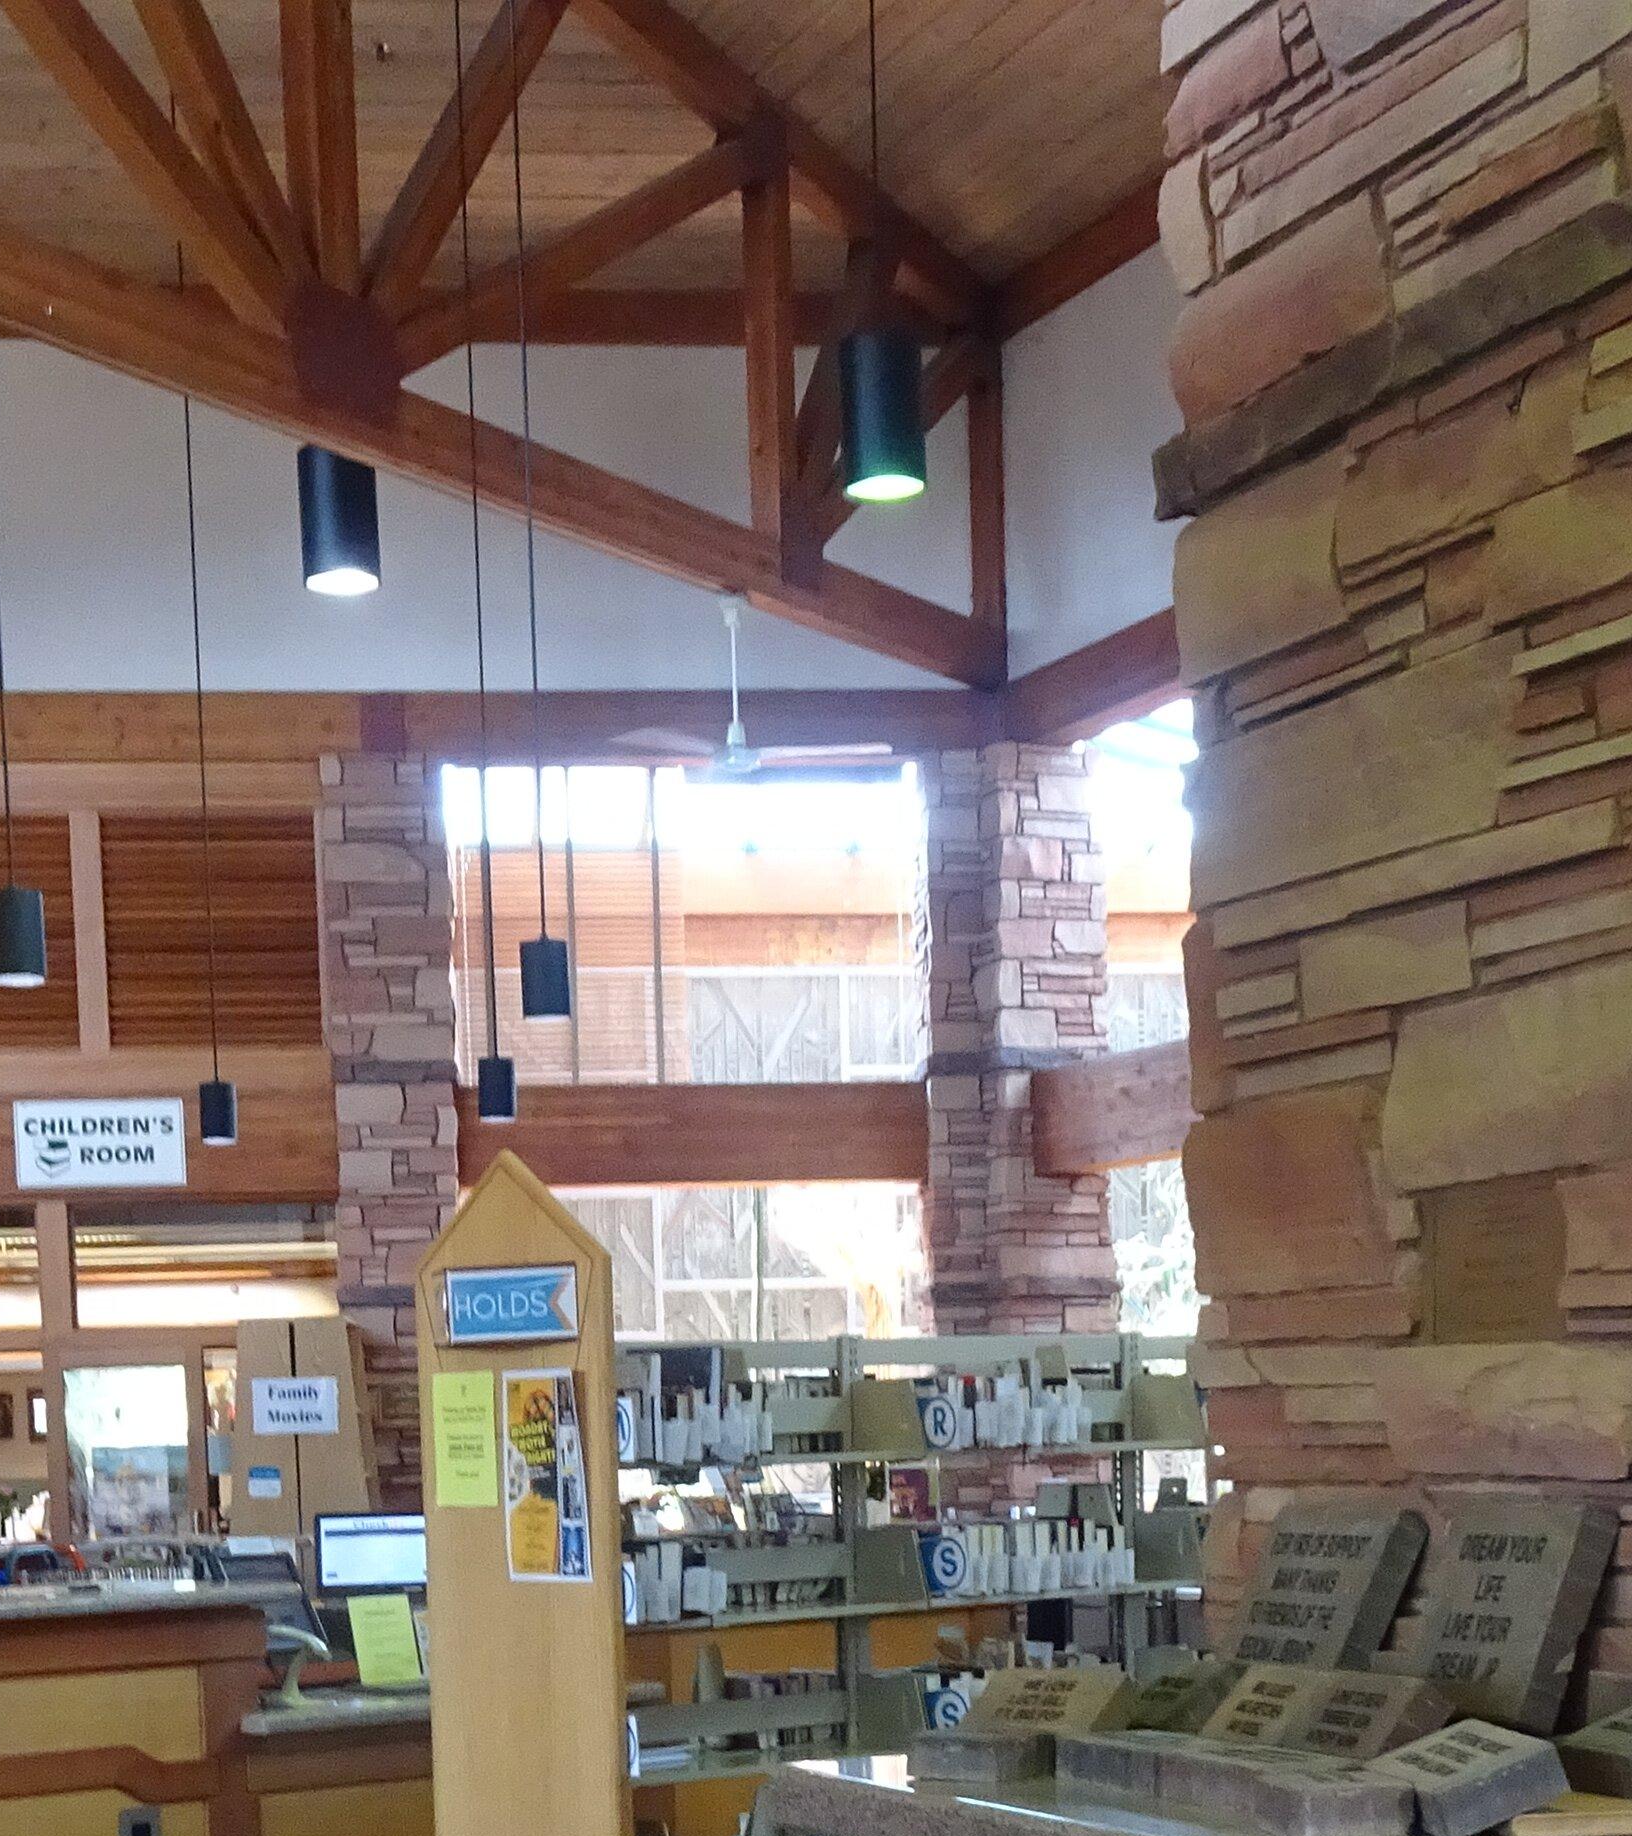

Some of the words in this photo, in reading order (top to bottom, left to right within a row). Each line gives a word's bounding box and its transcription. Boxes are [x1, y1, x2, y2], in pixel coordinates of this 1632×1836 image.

[23, 1117, 174, 1136] CHILDREN'S
[79, 1145, 155, 1165] ROOM
[454, 1290, 549, 1321] HOLDS
[268, 1385, 320, 1402] Family
[268, 1409, 323, 1423] Movies
[933, 1407, 947, 1436] R
[940, 1547, 957, 1577] S
